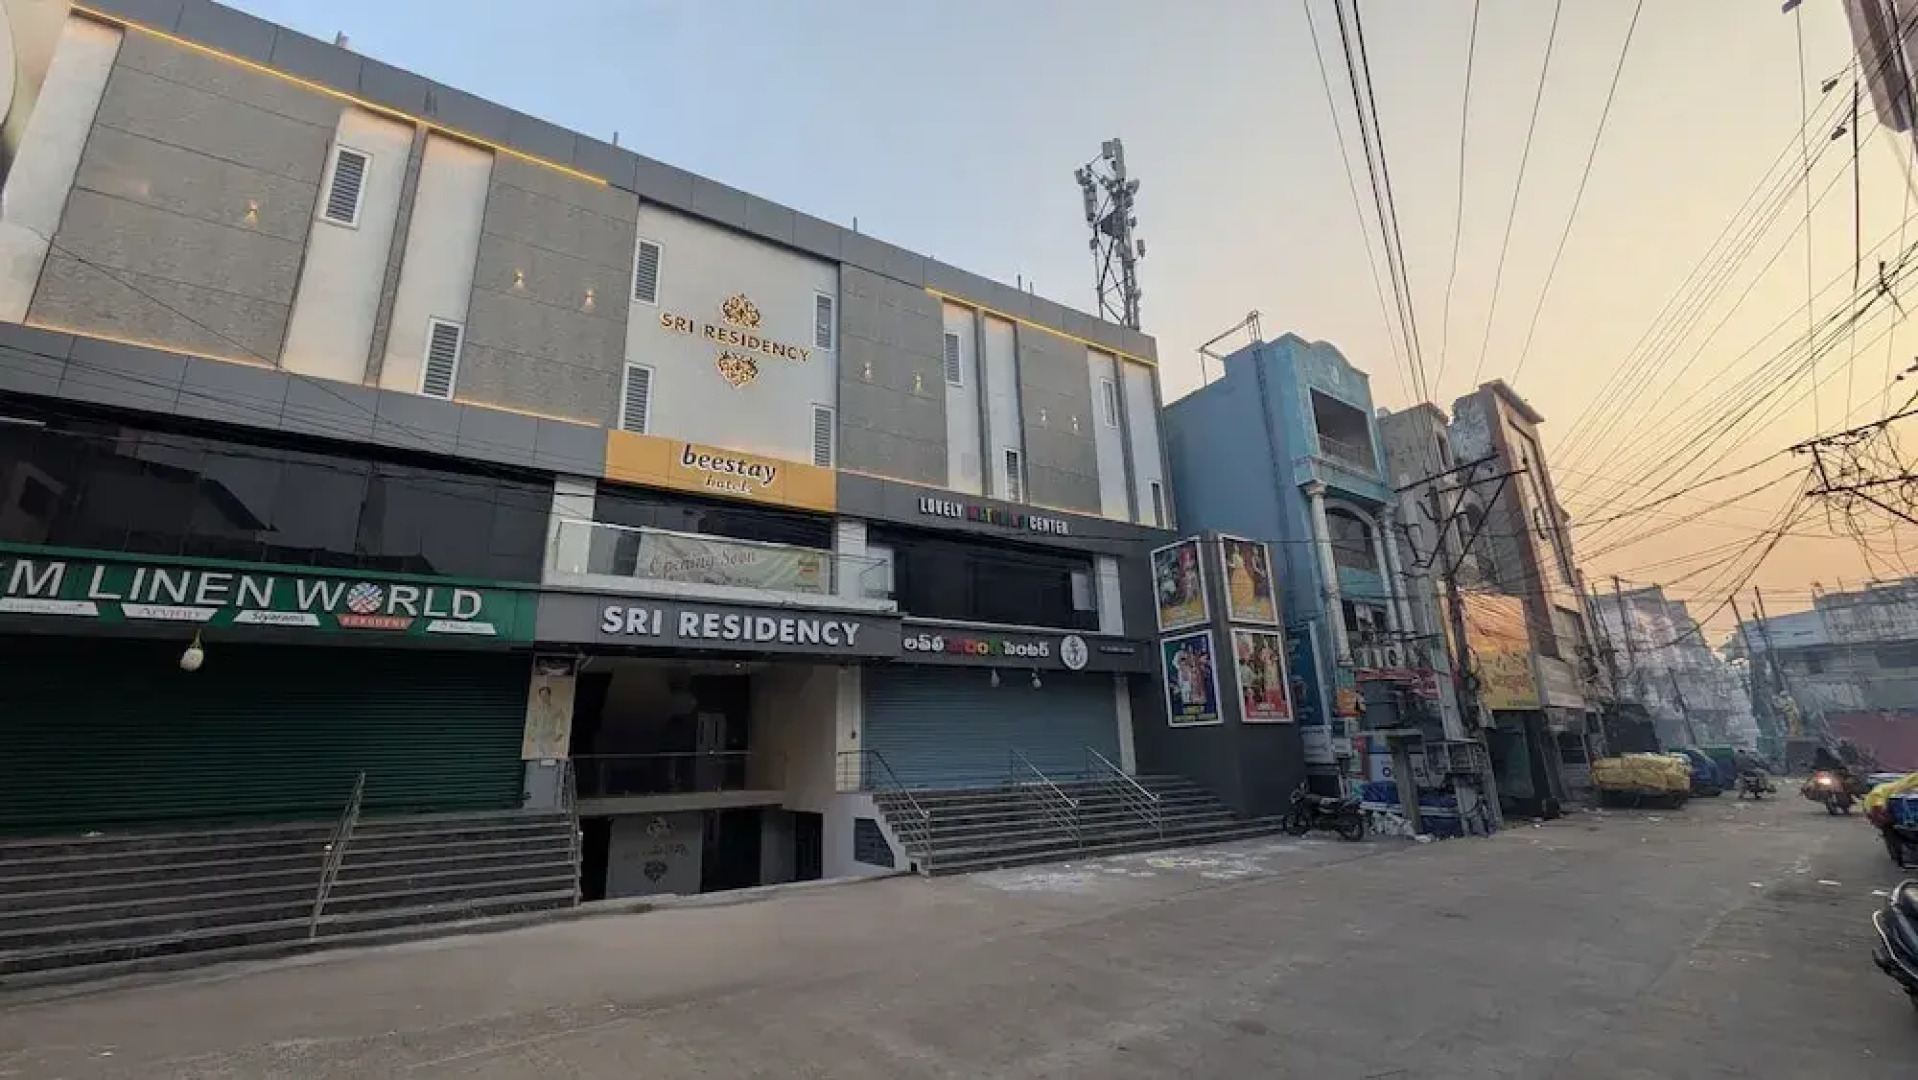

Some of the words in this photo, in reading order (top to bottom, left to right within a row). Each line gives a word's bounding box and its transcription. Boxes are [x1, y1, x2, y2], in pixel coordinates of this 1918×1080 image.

[660, 312, 695, 333] SRI
[702, 324, 811, 363] RESIDENCY
[681, 443, 777, 487] beestay
[919, 496, 964, 518] LOVELY
[1029, 515, 1070, 535] CENTER
[0, 559, 66, 597] M
[87, 564, 277, 609] LINEN
[296, 577, 483, 620] WORLD
[601, 605, 663, 635] SRI
[677, 610, 861, 647] RESIDENCY
